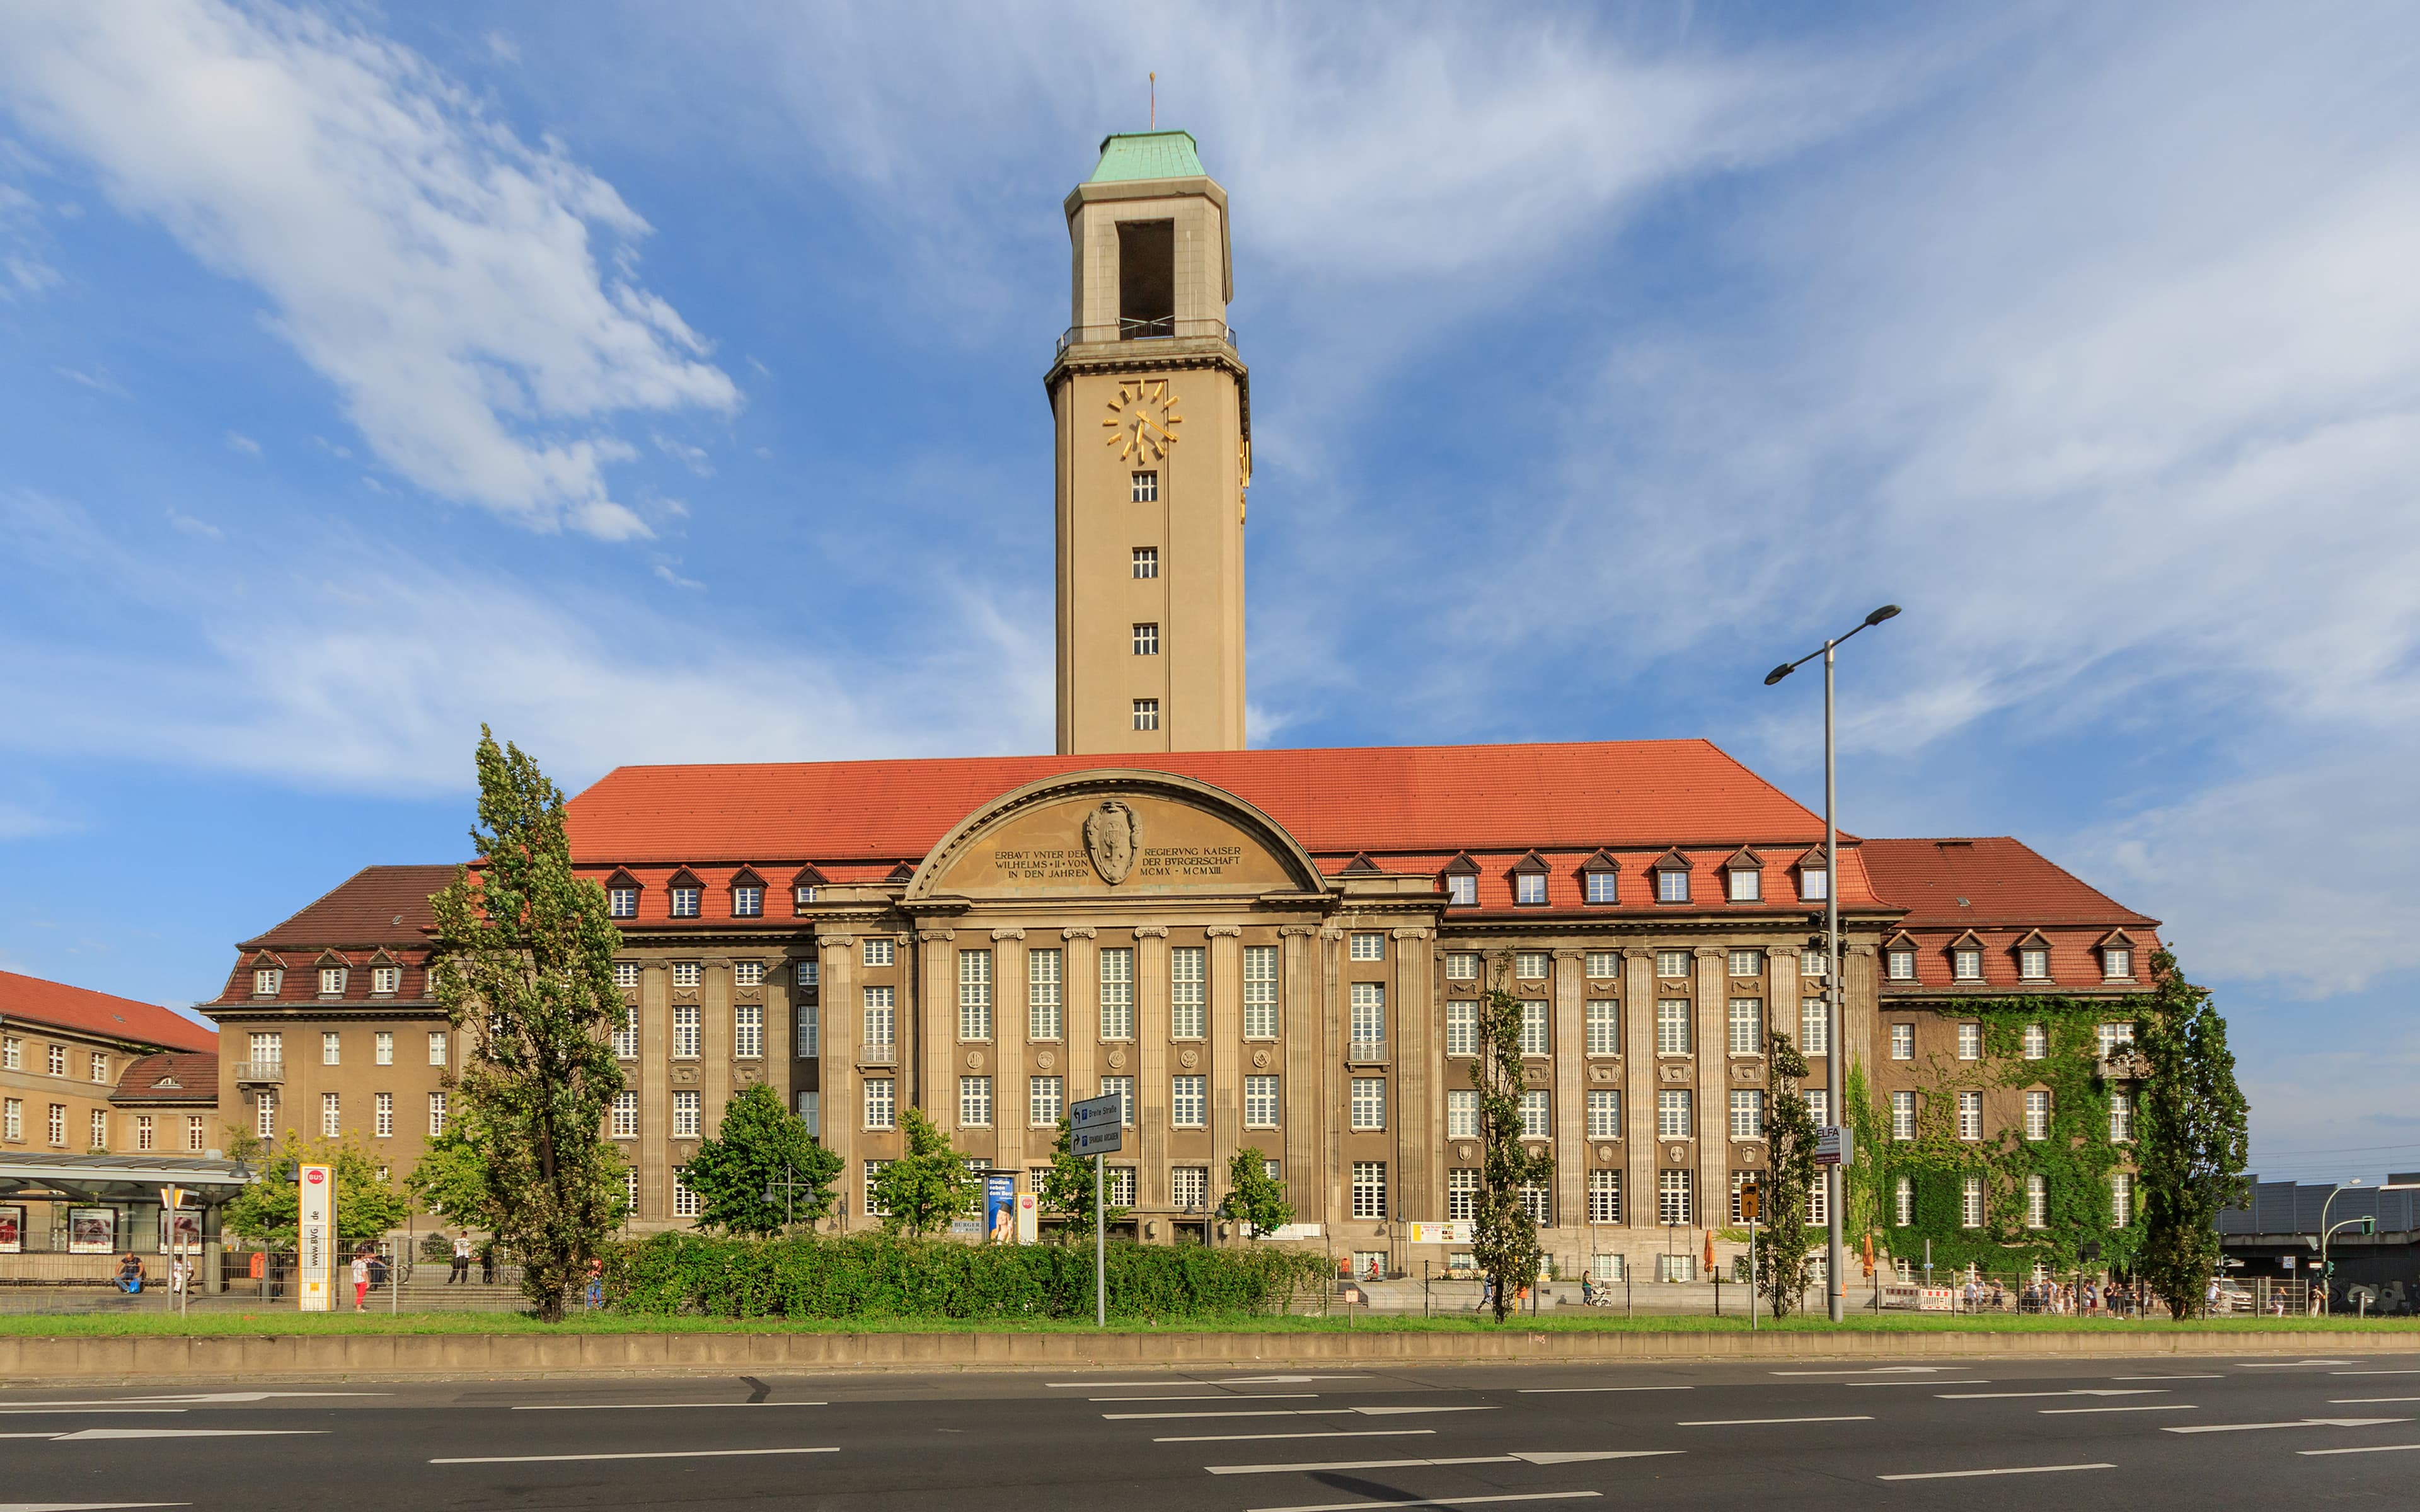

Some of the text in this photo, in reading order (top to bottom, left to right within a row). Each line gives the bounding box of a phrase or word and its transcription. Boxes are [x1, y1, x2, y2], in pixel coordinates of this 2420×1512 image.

[995, 851, 1030, 859] ERBAVT
[1034, 850, 1064, 859] VNTER
[1144, 847, 1198, 856] REGIERVNG
[1204, 847, 1241, 855] KAISER
[995, 861, 1047, 869] WILHELMS
[1068, 859, 1088, 868] VON
[1143, 857, 1161, 866] DER
[1049, 869, 1088, 878] JAHREN
[1140, 867, 1170, 876] MCMX
